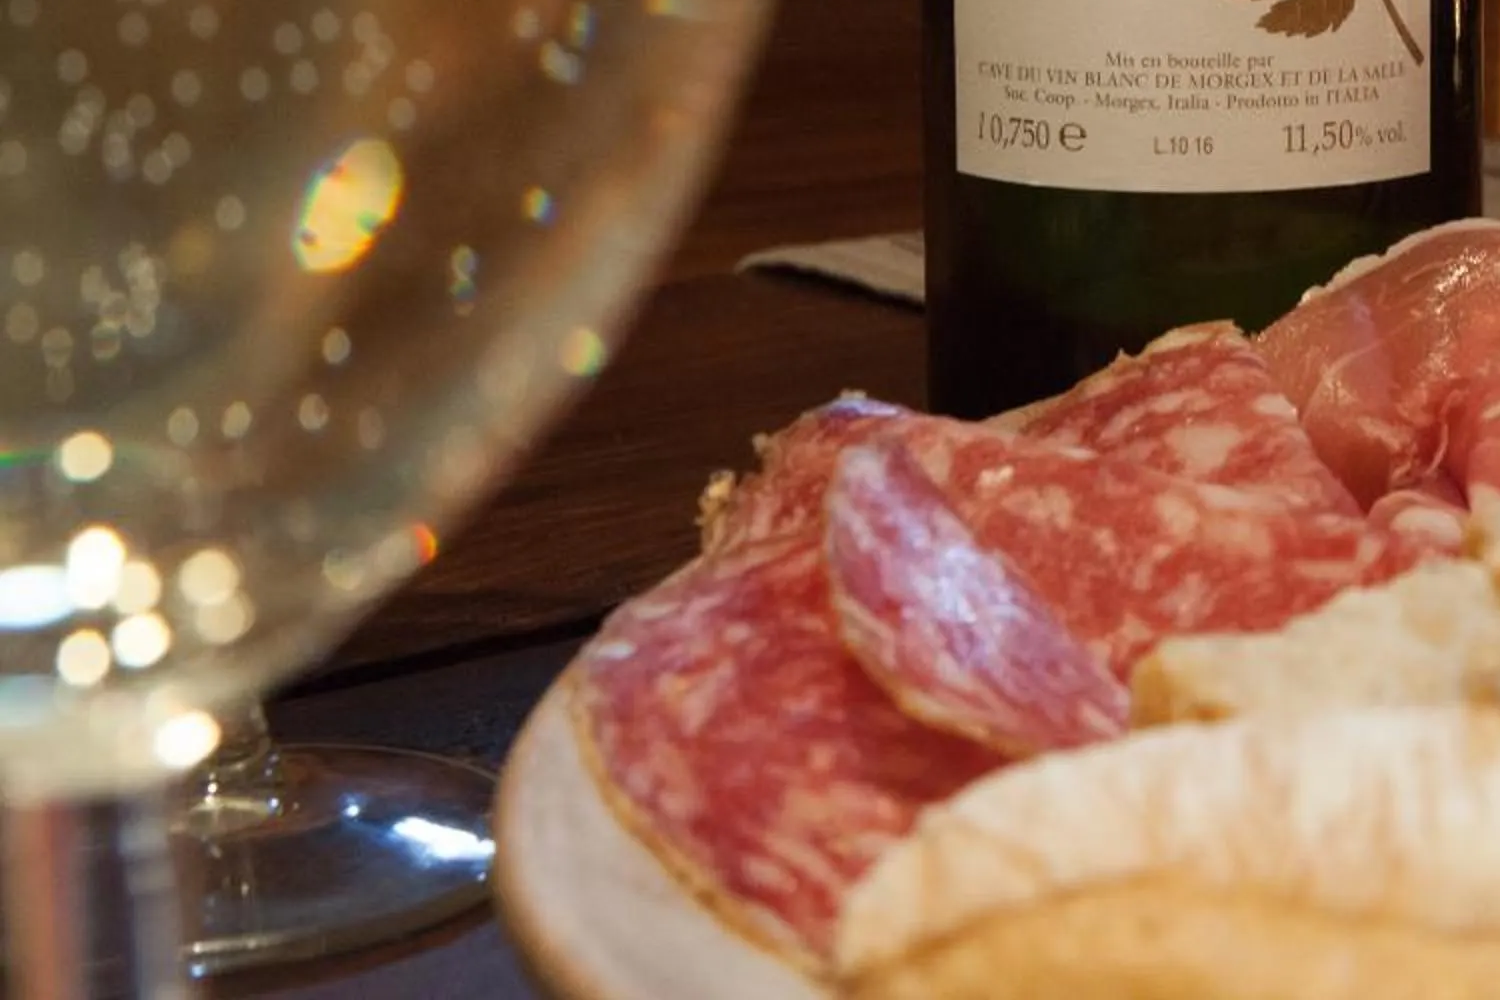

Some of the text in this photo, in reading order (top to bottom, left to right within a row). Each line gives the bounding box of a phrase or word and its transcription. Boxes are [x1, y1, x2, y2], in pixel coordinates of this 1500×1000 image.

[1105, 51, 1275, 72] Mis en bouteille par
[1046, 67, 1078, 85] VIN
[1085, 71, 1148, 88] BLANC
[1155, 72, 1181, 89] DE
[1188, 72, 1273, 89] MORGEX
[1337, 67, 1359, 83] LA
[1167, 94, 1209, 110] Italia
[1226, 93, 1300, 110] Prodotto
[1304, 91, 1320, 106] in
[1326, 86, 1380, 106] ITALIA
[989, 113, 1051, 150] 0,750
